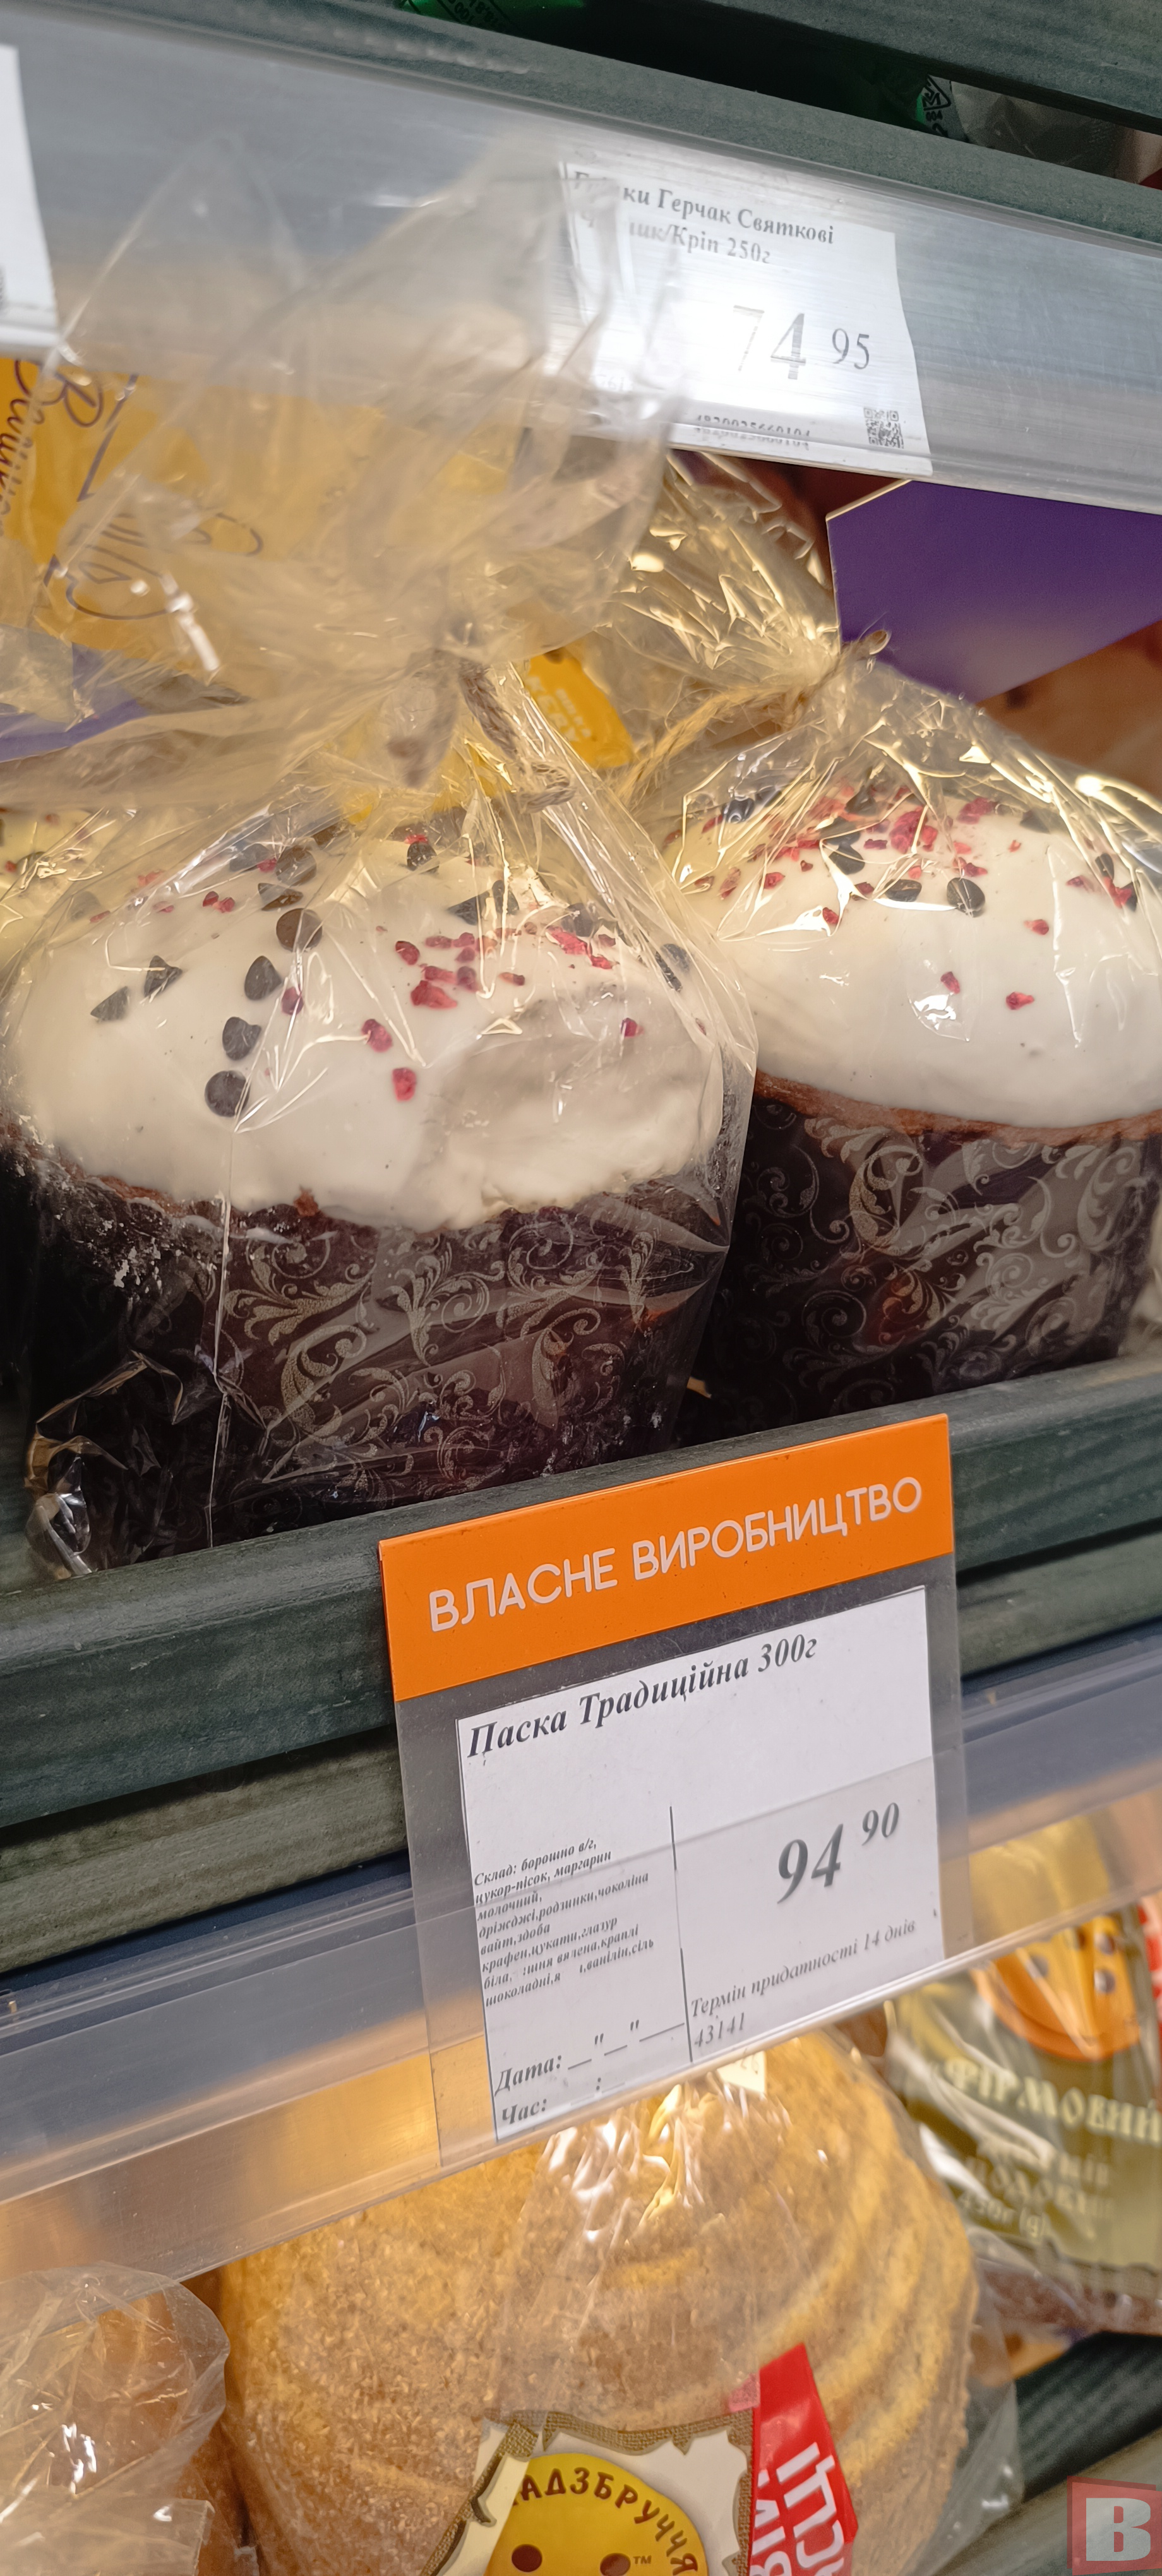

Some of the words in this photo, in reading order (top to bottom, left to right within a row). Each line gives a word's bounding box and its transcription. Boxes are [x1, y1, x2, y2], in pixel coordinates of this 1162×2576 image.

[657, 188, 731, 225] Герчак
[738, 208, 834, 244] Святкові
[728, 237, 770, 264] 250г
[733, 305, 806, 379] 74
[832, 328, 869, 370] 95
[429, 1547, 618, 1631] ВЛАСНЕ
[632, 1476, 922, 1581] ВИРОБНИЦТВО
[467, 1707, 566, 1757] Паска
[579, 1654, 748, 1727] Традиційна
[758, 1634, 817, 1674] 300г
[474, 1864, 517, 1886] Склад:
[521, 1845, 575, 1871] борошно
[578, 1837, 597, 1852] в/г,
[476, 1872, 551, 1904] цукор-пісок,
[554, 1851, 611, 1878] маргарин
[777, 1823, 843, 1904] 94
[861, 1803, 899, 1846] 90
[477, 1890, 542, 1921] молочний,
[480, 1923, 551, 1955] вайт,здоба
[484, 1972, 513, 1989] біла,
[691, 1985, 745, 2018] Термін
[752, 1939, 857, 1996] придатності
[864, 1930, 880, 1950] 14
[884, 1919, 915, 1941] днів
[694, 2012, 745, 2048] 43141
[494, 2055, 561, 2097] Дата:
[502, 2099, 547, 2125] Час:
[513, 2467, 698, 2576] АДЗБРУЧЧЯ
